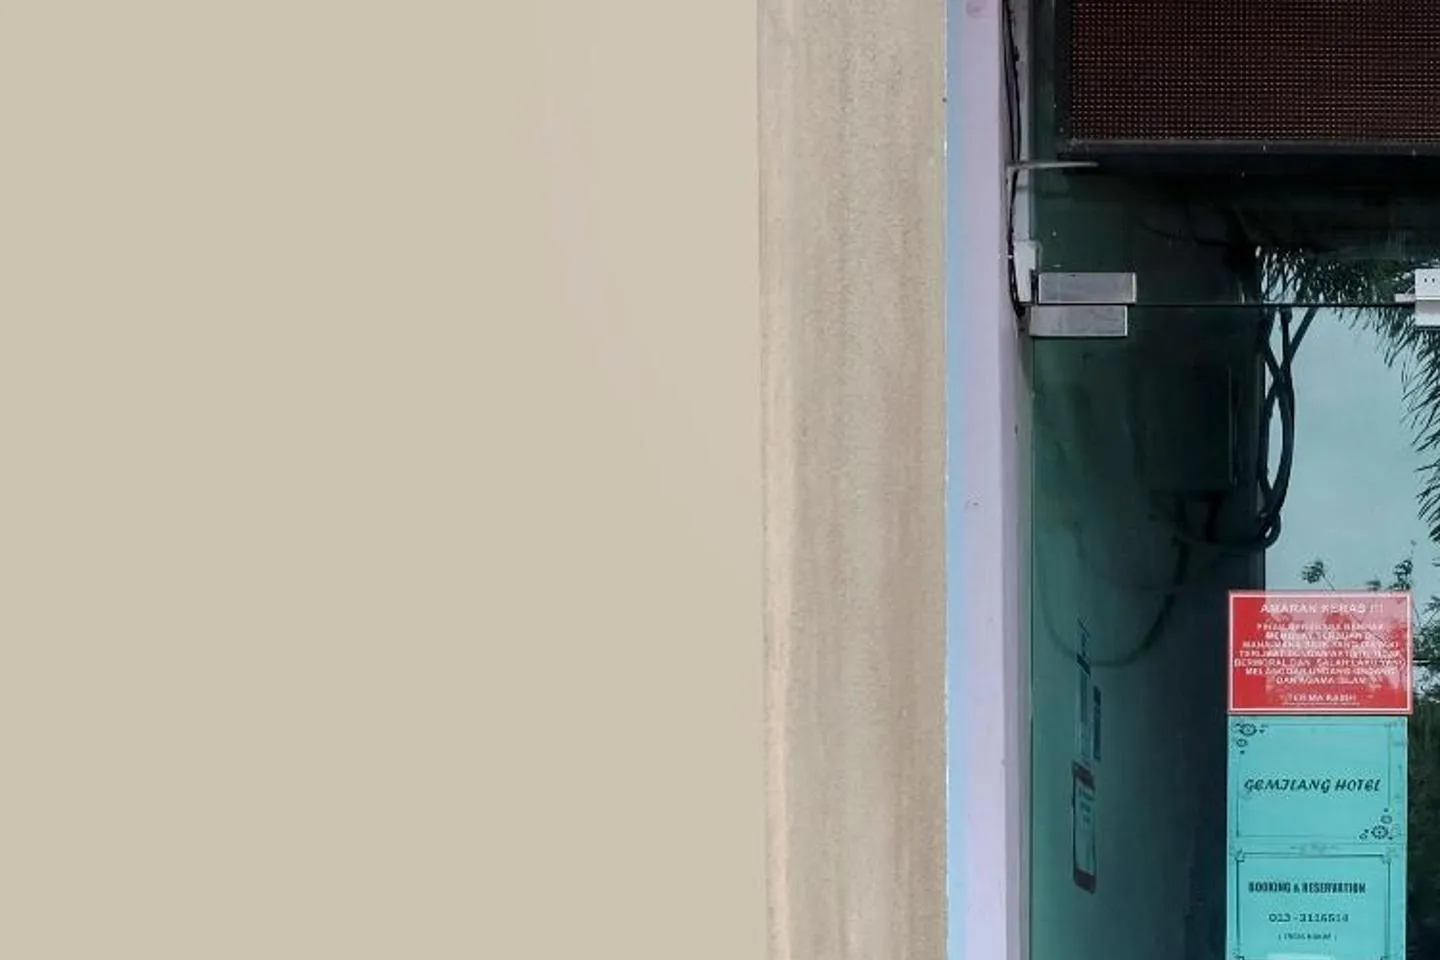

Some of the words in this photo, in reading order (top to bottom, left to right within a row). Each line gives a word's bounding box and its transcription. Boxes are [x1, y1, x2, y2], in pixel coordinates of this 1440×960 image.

[1334, 778, 1381, 792] HOTEL
[1248, 881, 1291, 894] BOOKING
[1301, 881, 1366, 894] RESERVATION
